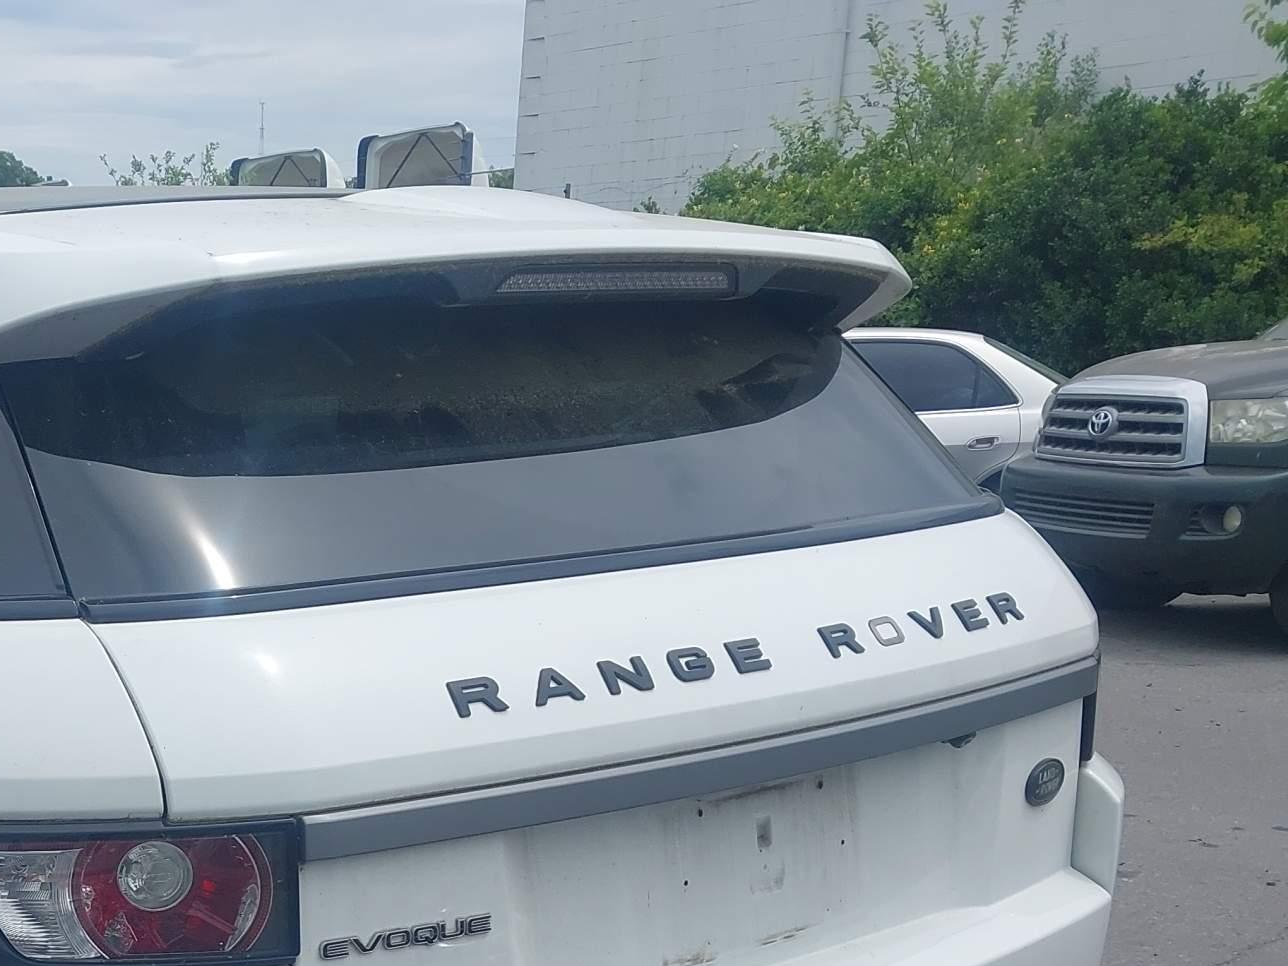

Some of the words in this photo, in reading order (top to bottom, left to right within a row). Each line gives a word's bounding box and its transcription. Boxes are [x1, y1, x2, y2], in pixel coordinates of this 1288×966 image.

[445, 636, 772, 718] RANGE
[816, 591, 1025, 659] ROVER
[319, 912, 493, 960] EVOQUE
